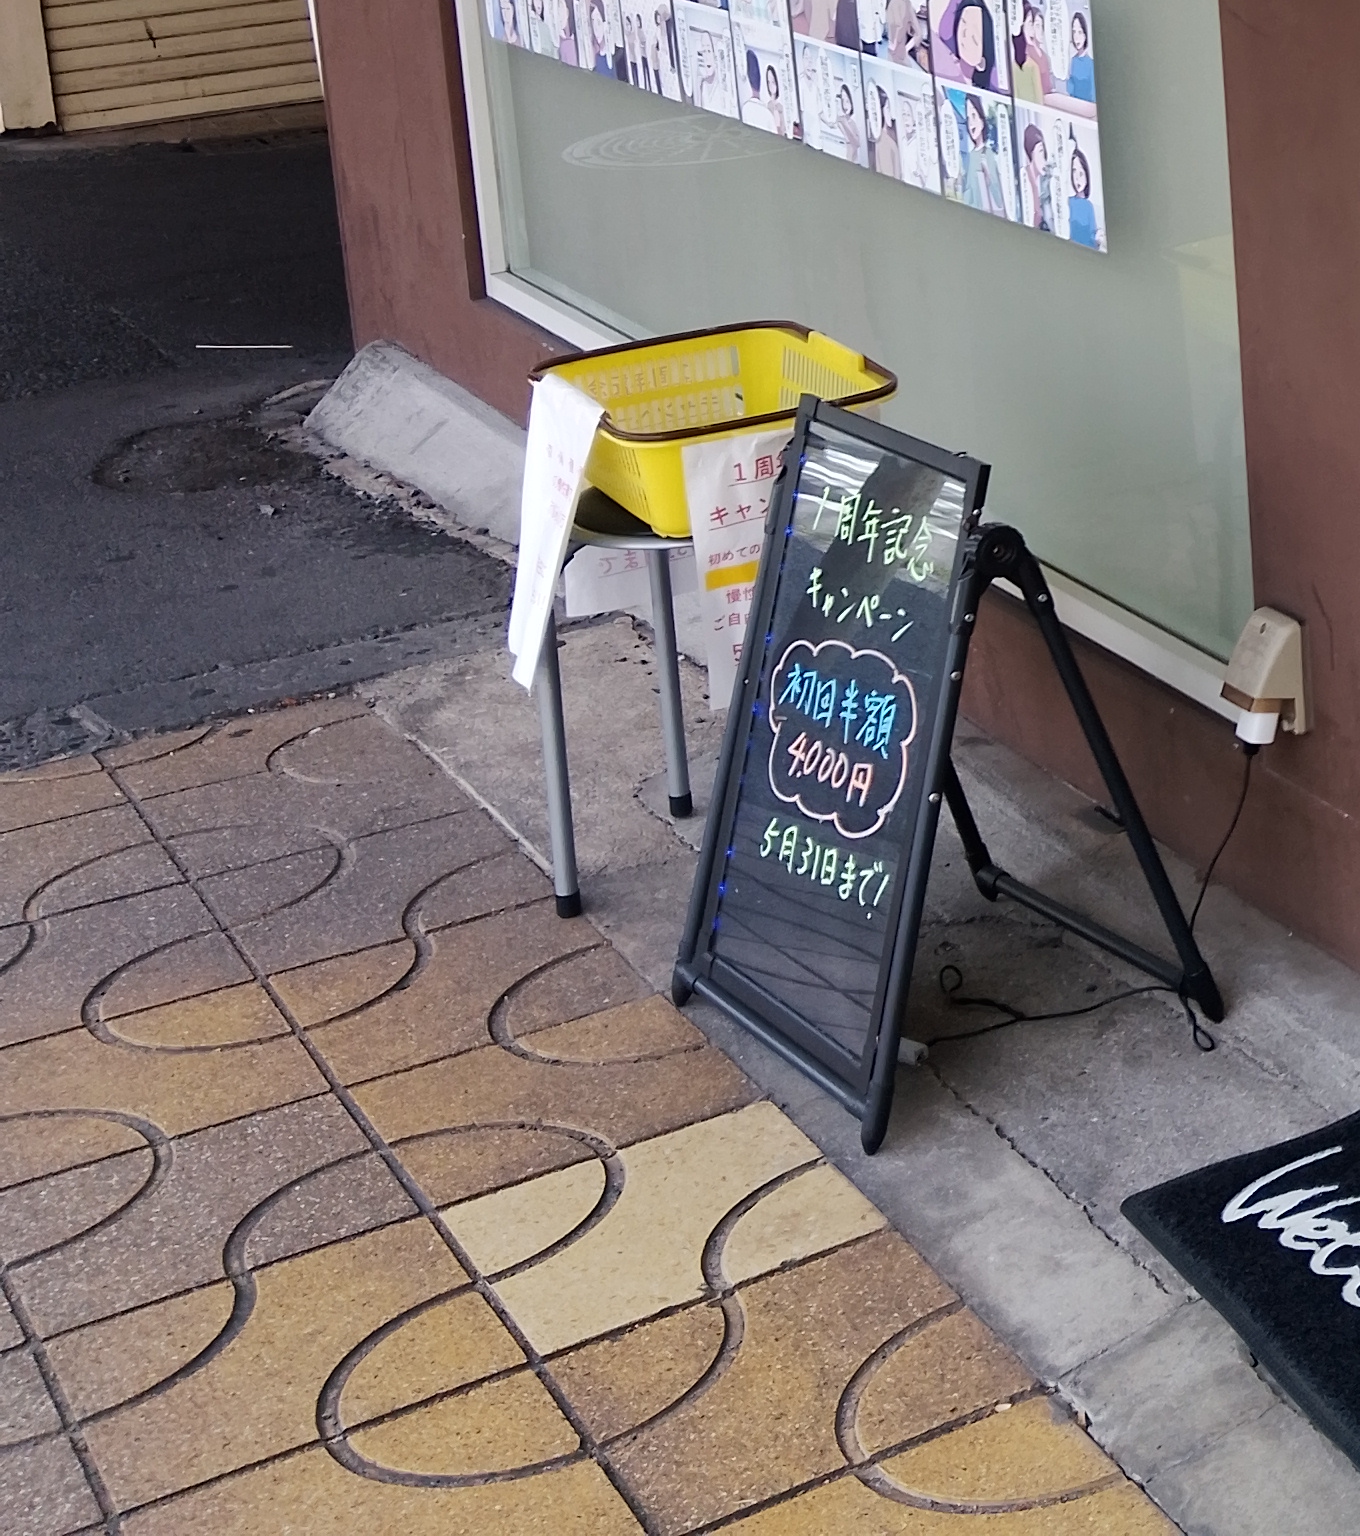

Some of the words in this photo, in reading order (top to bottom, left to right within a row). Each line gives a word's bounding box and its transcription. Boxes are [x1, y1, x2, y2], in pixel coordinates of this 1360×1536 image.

[811, 486, 935, 583] 1周年記念
[806, 566, 915, 643] キャンペーン
[778, 663, 897, 761] 初回半額
